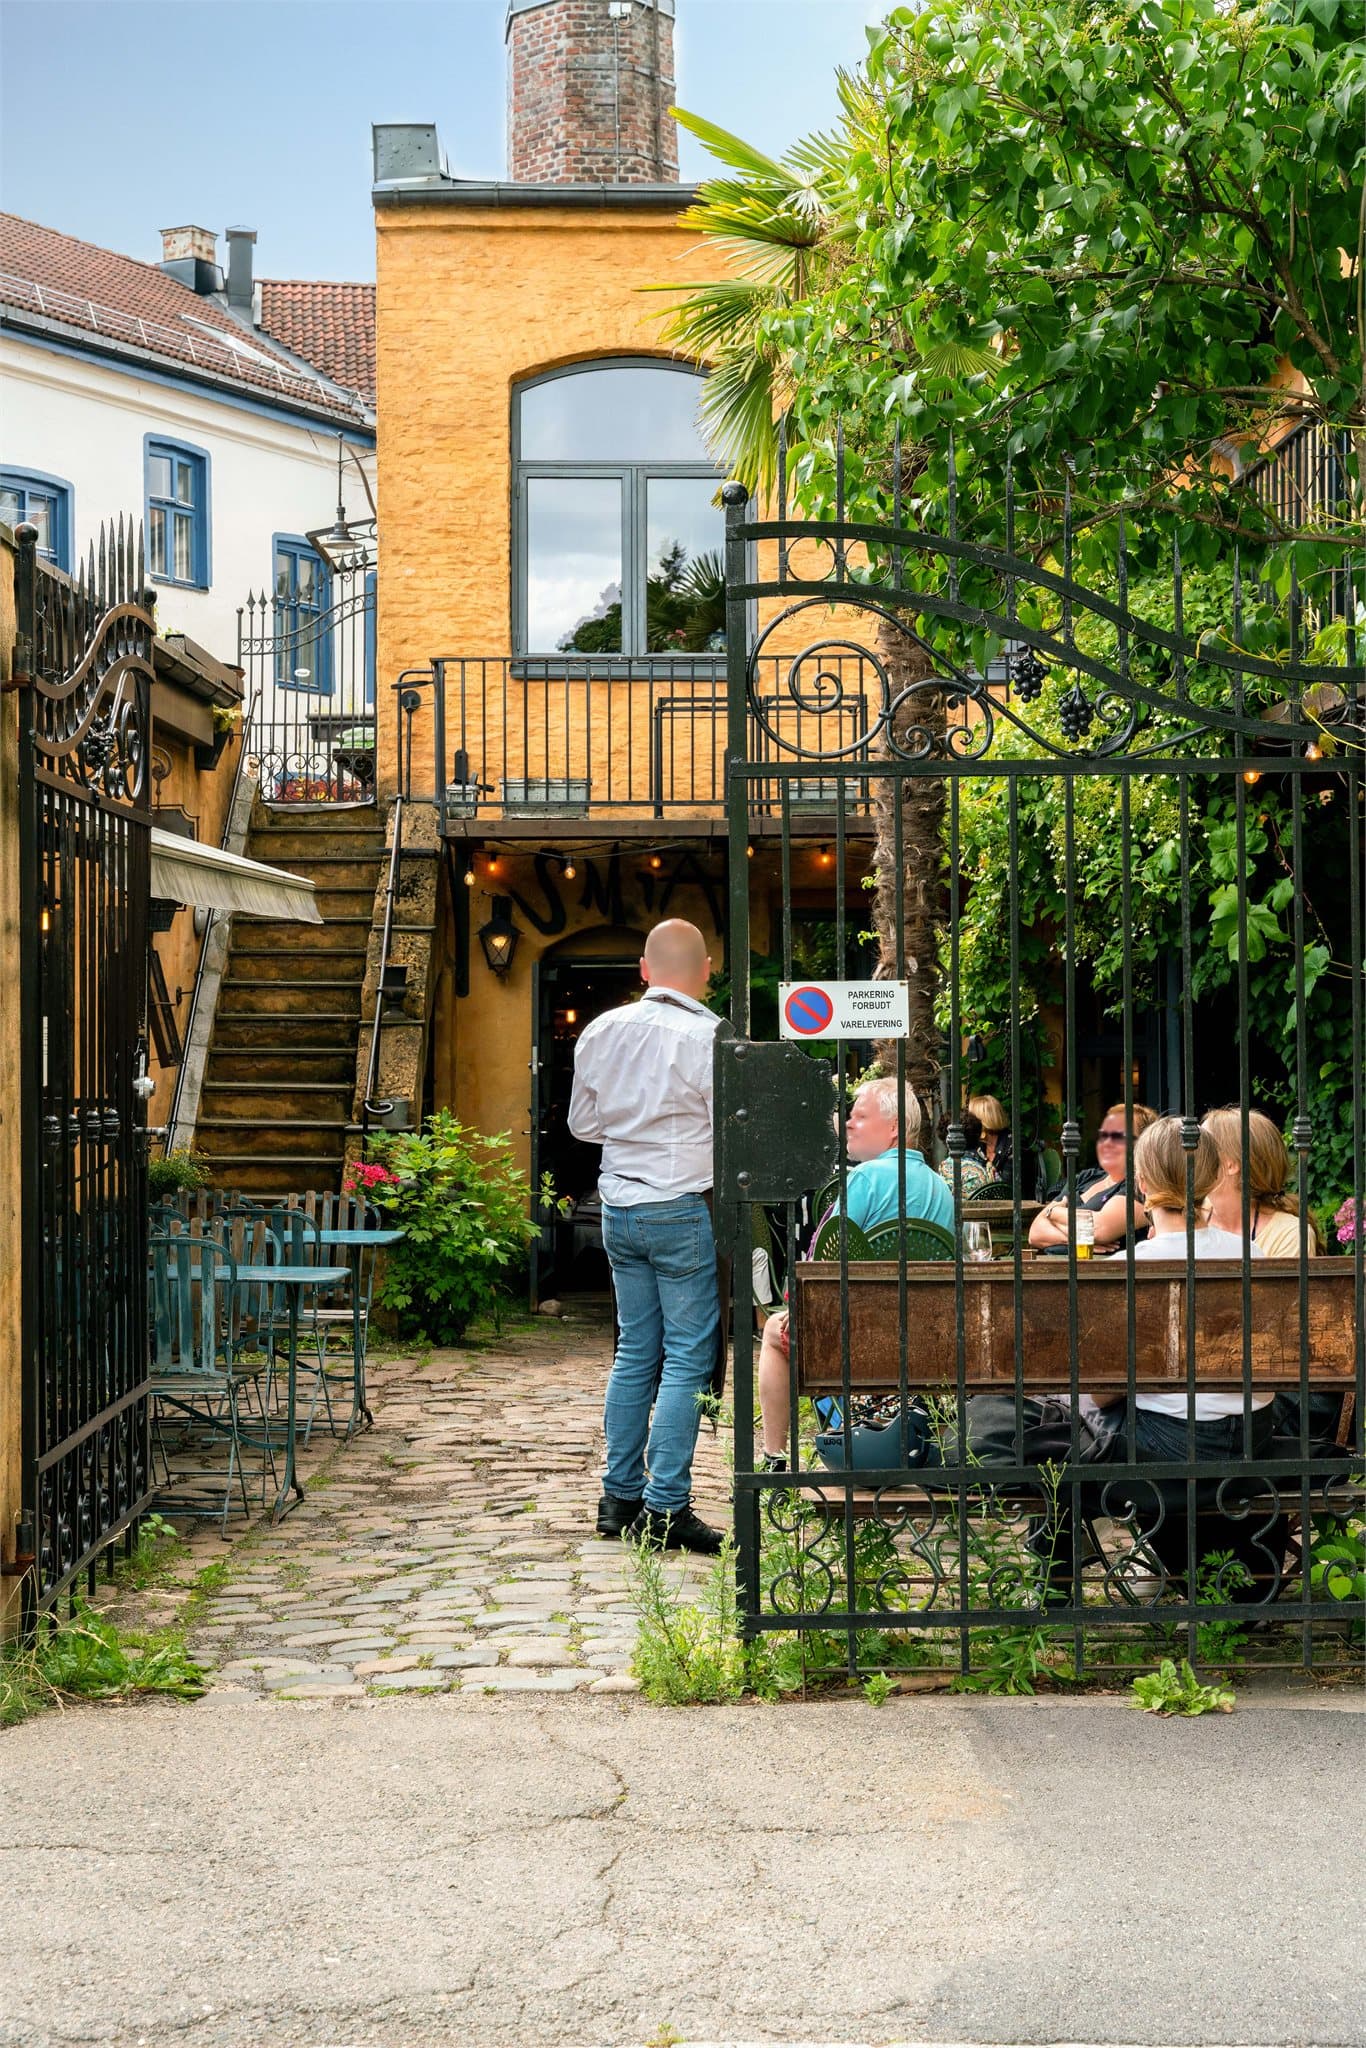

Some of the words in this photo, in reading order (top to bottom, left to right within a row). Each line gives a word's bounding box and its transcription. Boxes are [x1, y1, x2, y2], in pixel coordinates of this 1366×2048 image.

[848, 991, 894, 999] PARKERING
[852, 1001, 891, 1010] FORBUDT
[840, 1020, 902, 1028] VARELEVERING
